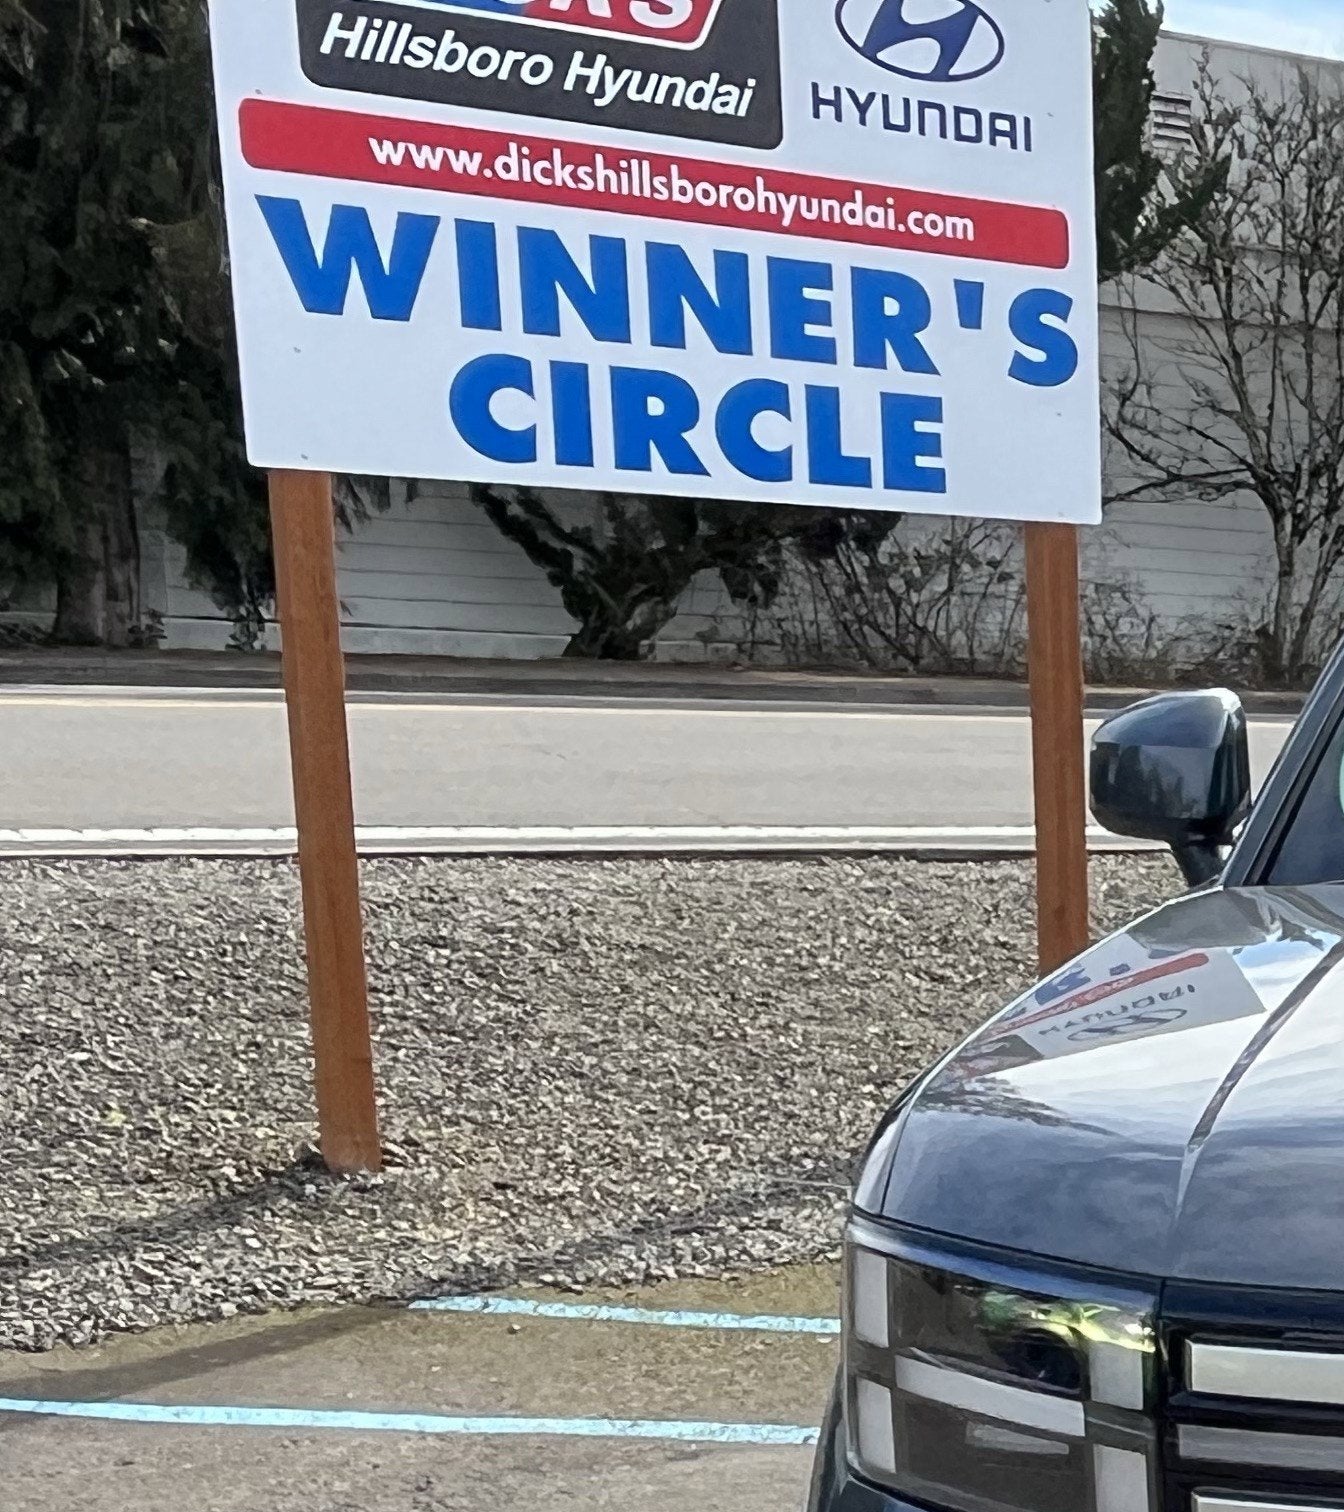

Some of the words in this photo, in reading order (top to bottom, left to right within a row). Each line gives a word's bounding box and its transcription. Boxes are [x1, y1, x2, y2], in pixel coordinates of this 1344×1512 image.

[319, 12, 553, 86] Hillsboro
[563, 50, 757, 117] Hyundai
[811, 81, 1032, 152] HYUNDAI
[368, 136, 975, 242] www.dickshillsborohyundai.com
[254, 195, 1079, 388] WINNER'S
[449, 354, 947, 494] CIRCLE
